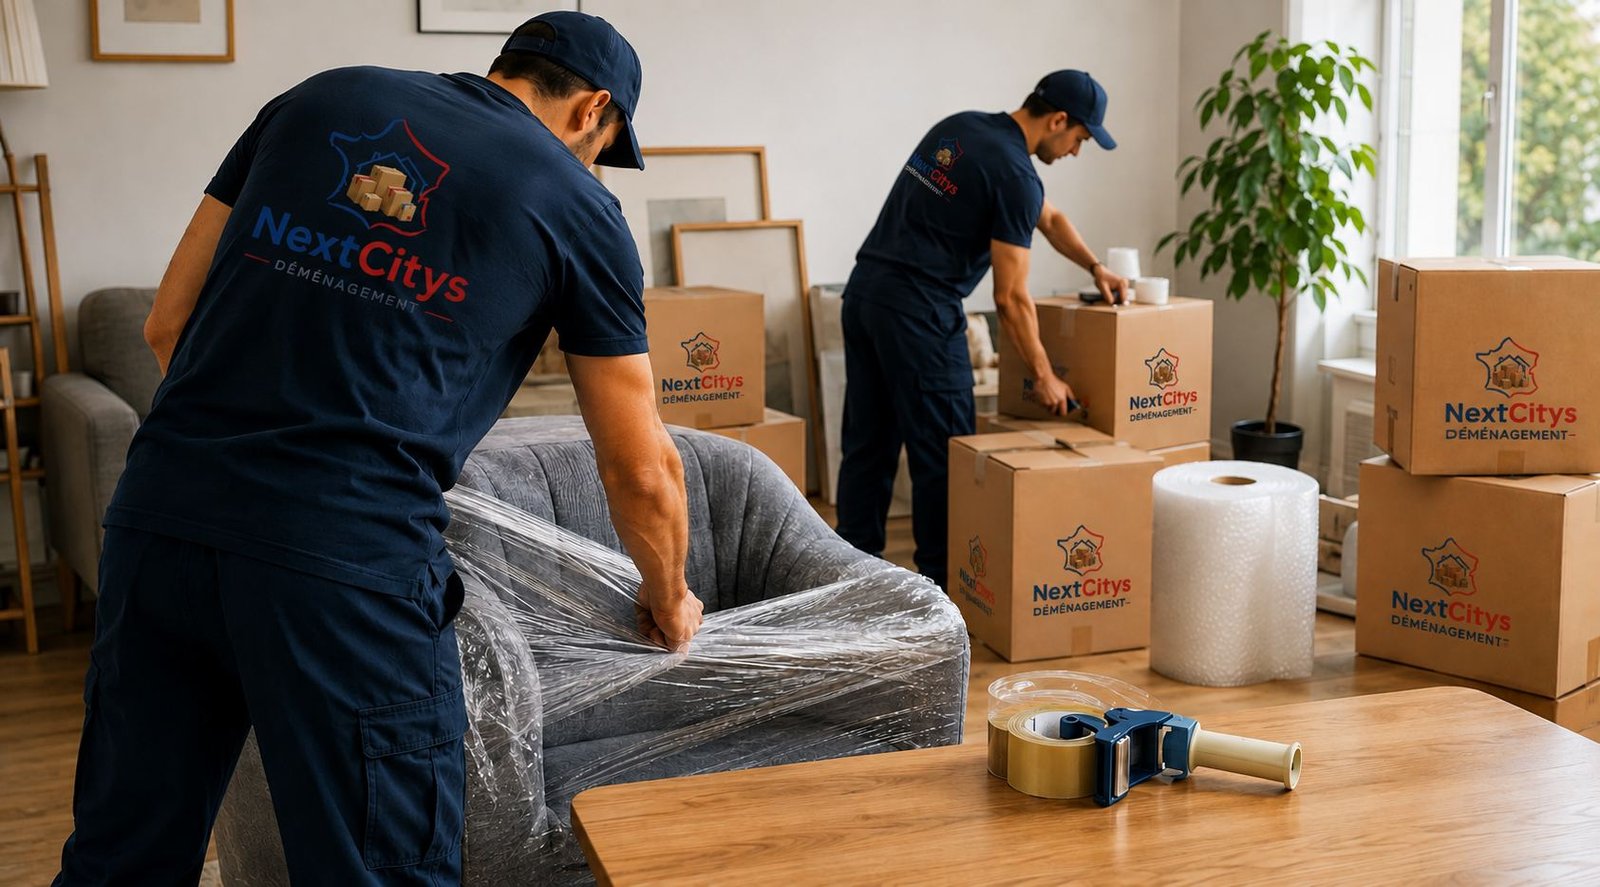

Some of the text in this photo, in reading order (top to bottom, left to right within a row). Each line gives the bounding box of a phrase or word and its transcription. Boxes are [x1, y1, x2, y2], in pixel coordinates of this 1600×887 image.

[252, 206, 469, 302] NextCitys
[274, 259, 420, 314] DÉMÉNAGEMENT
[662, 375, 744, 392] NextCitys
[1130, 390, 1198, 410] NextCitys
[1445, 403, 1577, 428] NextCitys
[1445, 427, 1568, 440] DÉMÉNAGEMENT
[1033, 578, 1131, 602] NextCitys
[1033, 598, 1126, 616] DÉMÉNAGEMENT
[1392, 590, 1511, 632] NextCitys
[1391, 615, 1502, 647] DÉMÉNAGEMENT
